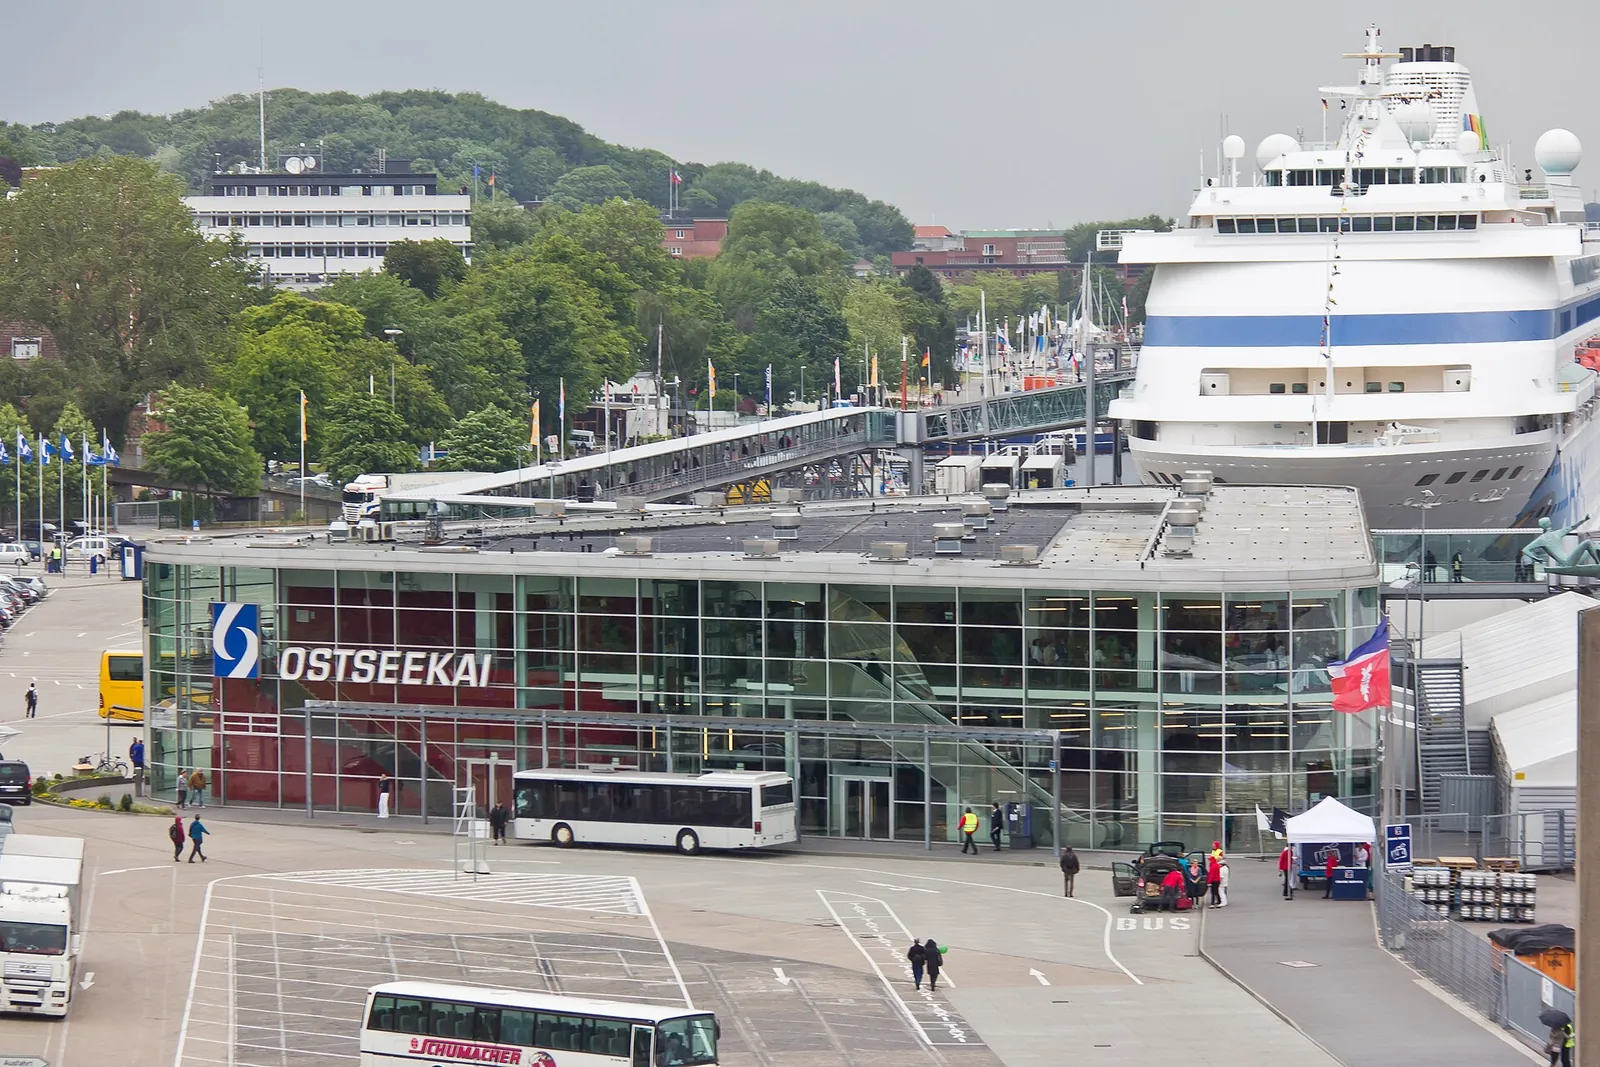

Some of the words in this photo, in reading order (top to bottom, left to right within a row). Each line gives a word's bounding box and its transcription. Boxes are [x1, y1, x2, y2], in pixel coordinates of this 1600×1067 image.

[279, 646, 492, 688] OSTSEEKAI
[1116, 917, 1191, 931] BUS
[408, 1038, 523, 1065] SCHUMACHER
